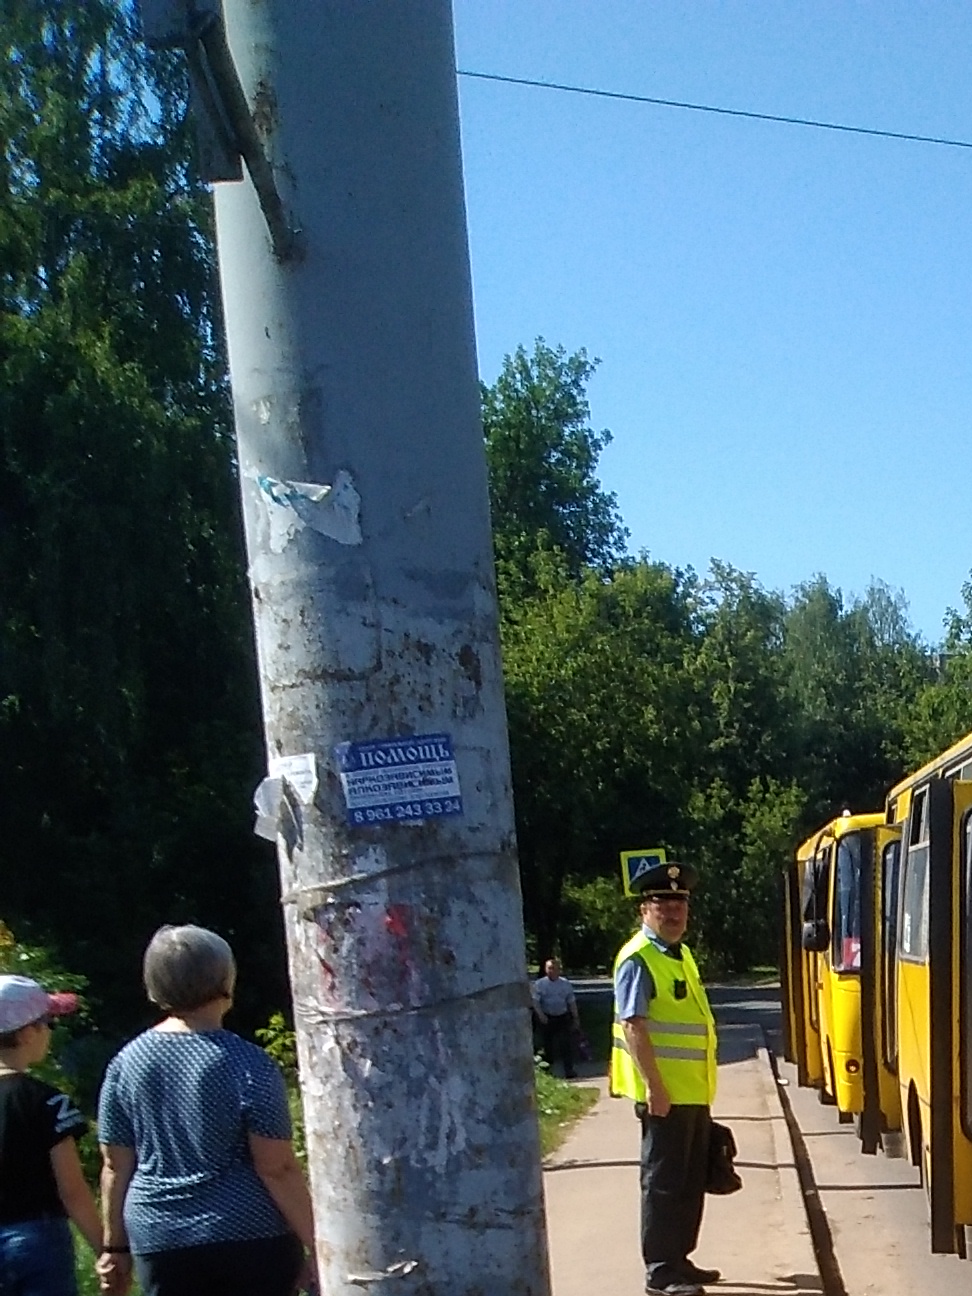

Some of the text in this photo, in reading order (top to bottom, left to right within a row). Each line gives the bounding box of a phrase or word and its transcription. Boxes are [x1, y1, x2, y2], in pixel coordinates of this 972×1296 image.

[360, 744, 450, 767] ПОМОЩЬ
[354, 811, 364, 823] 8
[366, 807, 394, 821] 961
[395, 803, 422, 818] 243
[425, 801, 443, 815] 33
